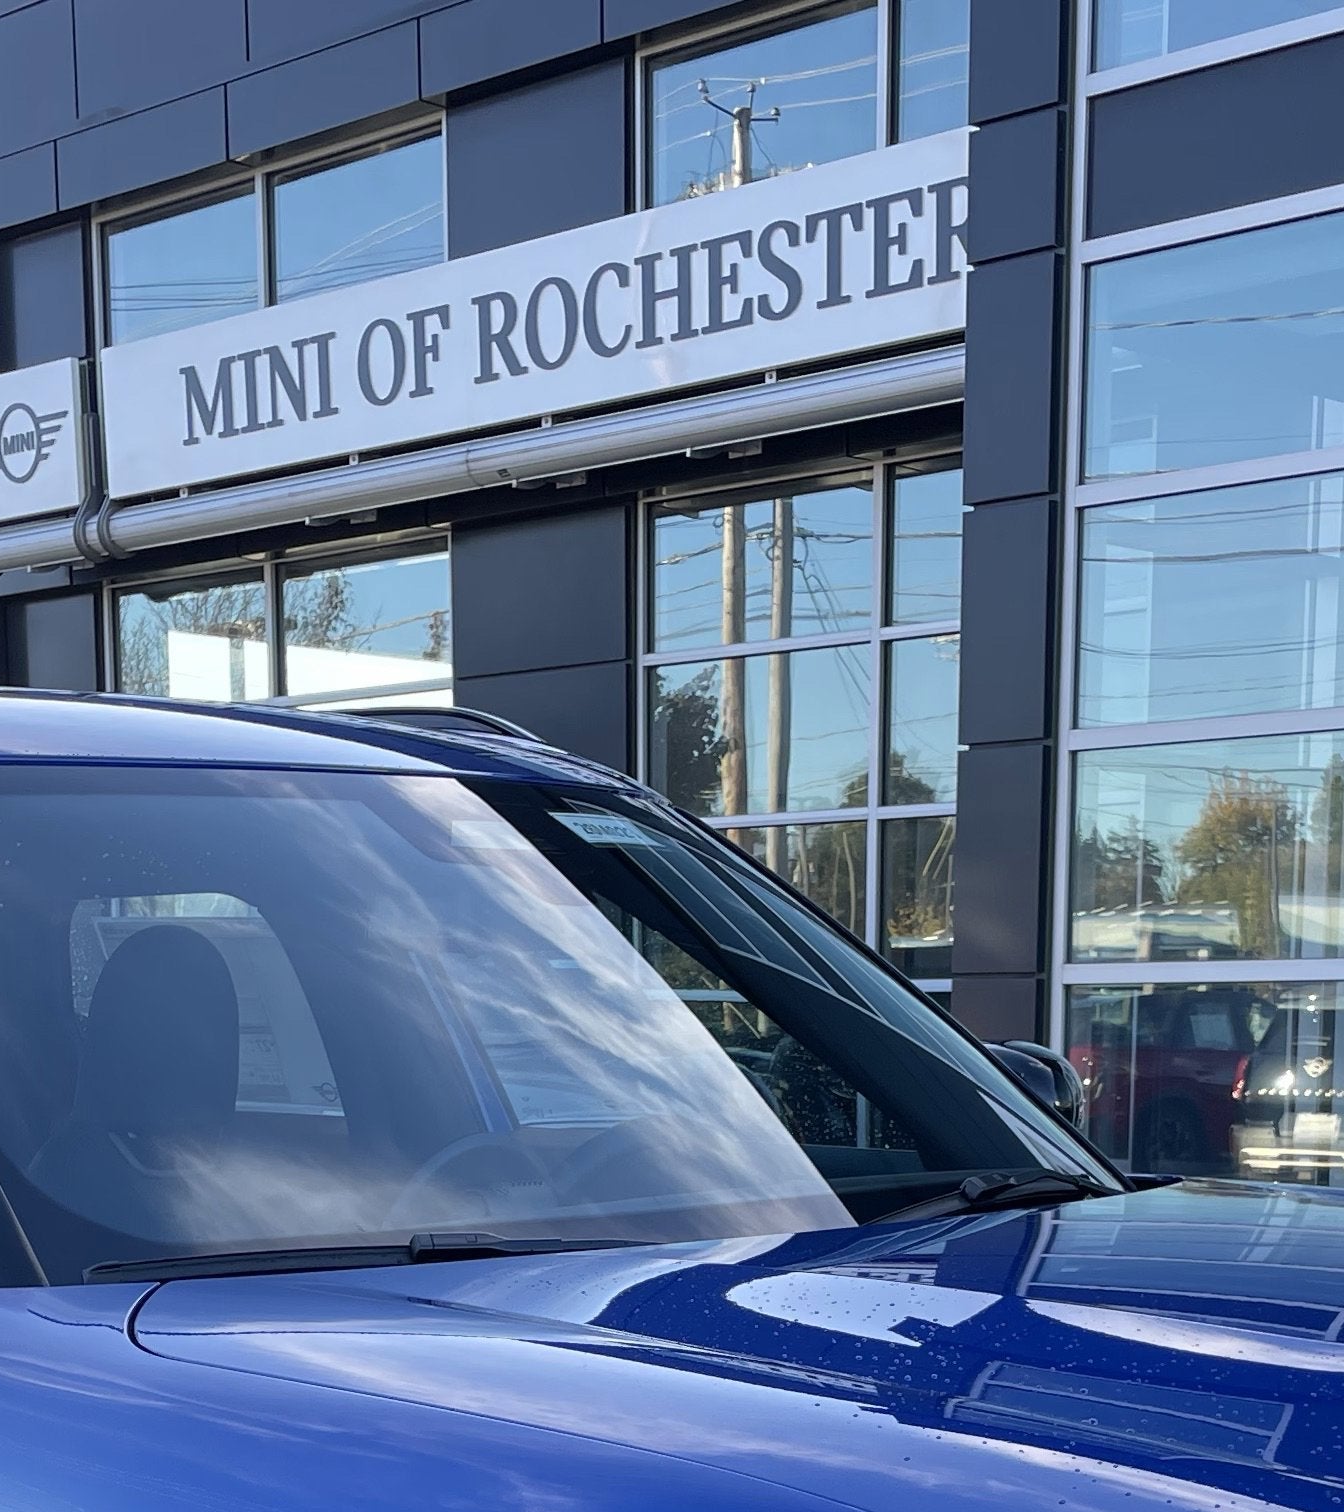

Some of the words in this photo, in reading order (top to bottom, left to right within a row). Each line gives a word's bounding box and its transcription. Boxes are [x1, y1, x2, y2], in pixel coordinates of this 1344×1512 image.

[179, 331, 339, 446] MINI
[358, 304, 450, 406] OF
[471, 175, 968, 384] ROCHESTER
[2, 431, 35, 456] MINI
